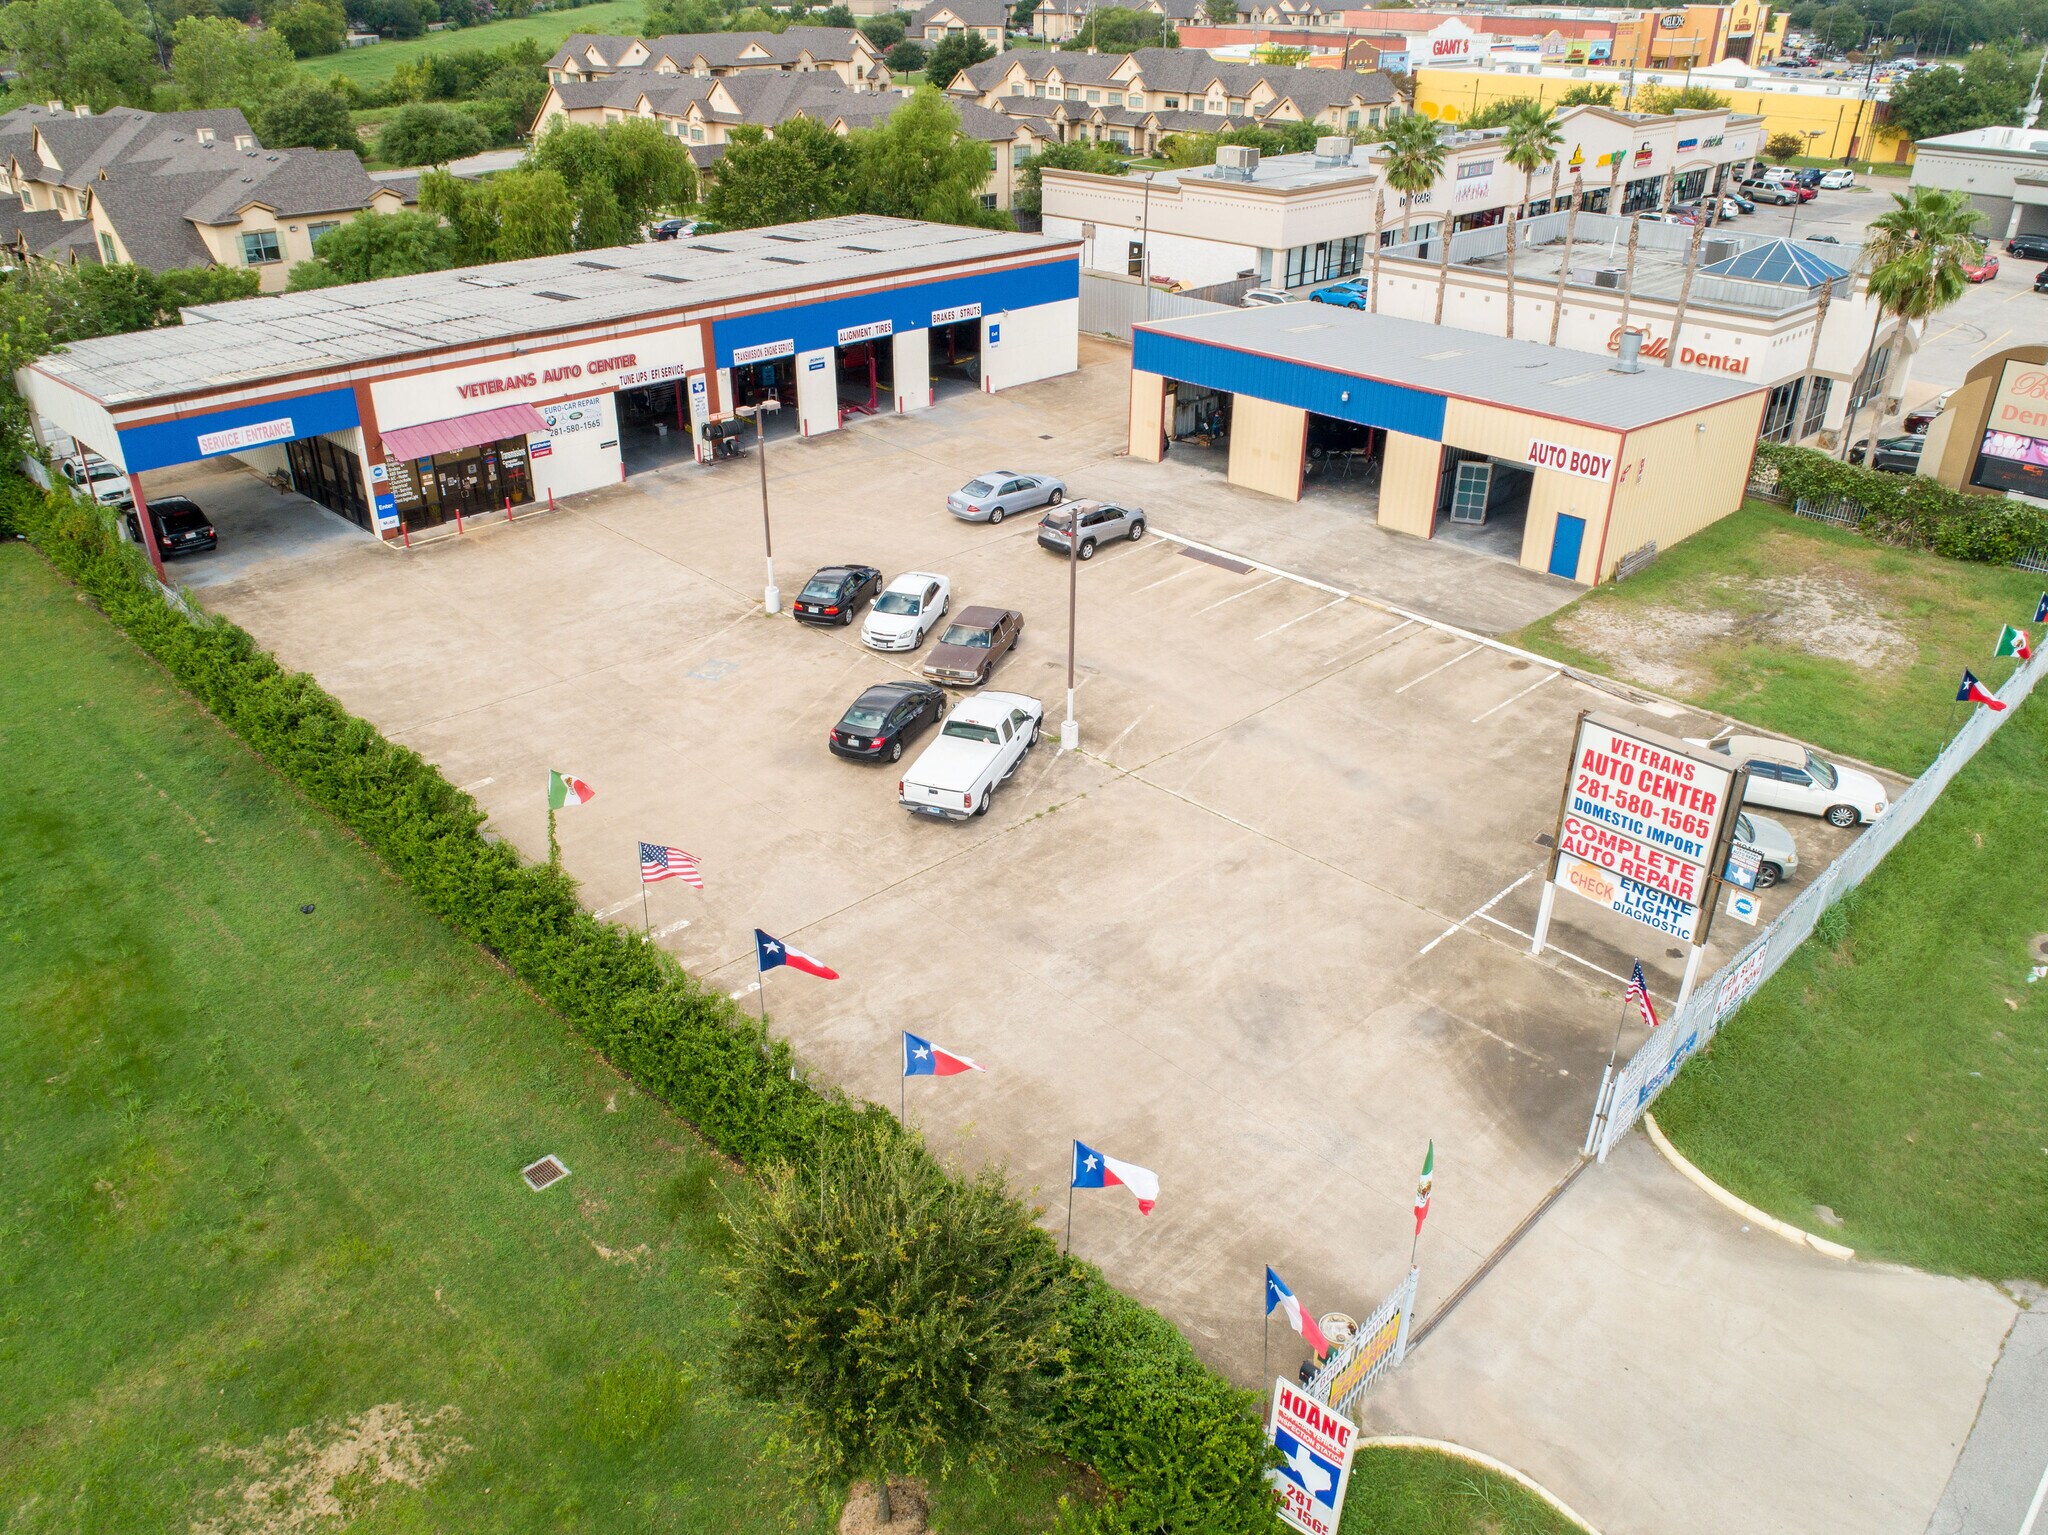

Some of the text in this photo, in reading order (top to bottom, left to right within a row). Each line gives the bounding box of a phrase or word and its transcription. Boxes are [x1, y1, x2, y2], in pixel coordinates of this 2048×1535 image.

[933, 305, 981, 324] BRAKES STRUTS
[839, 322, 892, 343] ALIGNMENT TIRES
[735, 341, 793, 362] TRANSMISSION ENGINE SERVICE
[1680, 347, 1749, 375] Dental
[457, 353, 637, 400] VETERANS AUTO CENTER
[620, 363, 684, 387] TUNE UPS EFI SERVICE
[544, 397, 600, 414] EURO-CAR REPAIR
[201, 421, 293, 452] SERVICE ENTRANCE
[550, 418, 601, 437] 281-580-1565
[1528, 441, 1567, 469] AUTO
[1570, 450, 1612, 479] BODY
[378, 503, 394, 511] Enter
[1611, 737, 1695, 781] VETERANS
[1581, 749, 1717, 816] AUTO CENTER
[1577, 774, 1710, 839] 281-580-1565
[1574, 797, 1703, 857] DOMESTIC IMPORT
[1562, 836, 1615, 867] AUTO
[1620, 858, 1693, 900] REPAIR
[1564, 818, 1696, 883] COMPLETE
[1570, 871, 1693, 916] CHECK ENGINE
[1624, 892, 1682, 924] LIGHT
[1613, 902, 1690, 940] DIAGNOSTIC
[1320, 1359, 1344, 1386] BODY
[1278, 1416, 1344, 1465] NSPECTION STATION
[1282, 1412, 1342, 1455] OFFICIAL VEHICLE
[1286, 1483, 1313, 1512] 281
